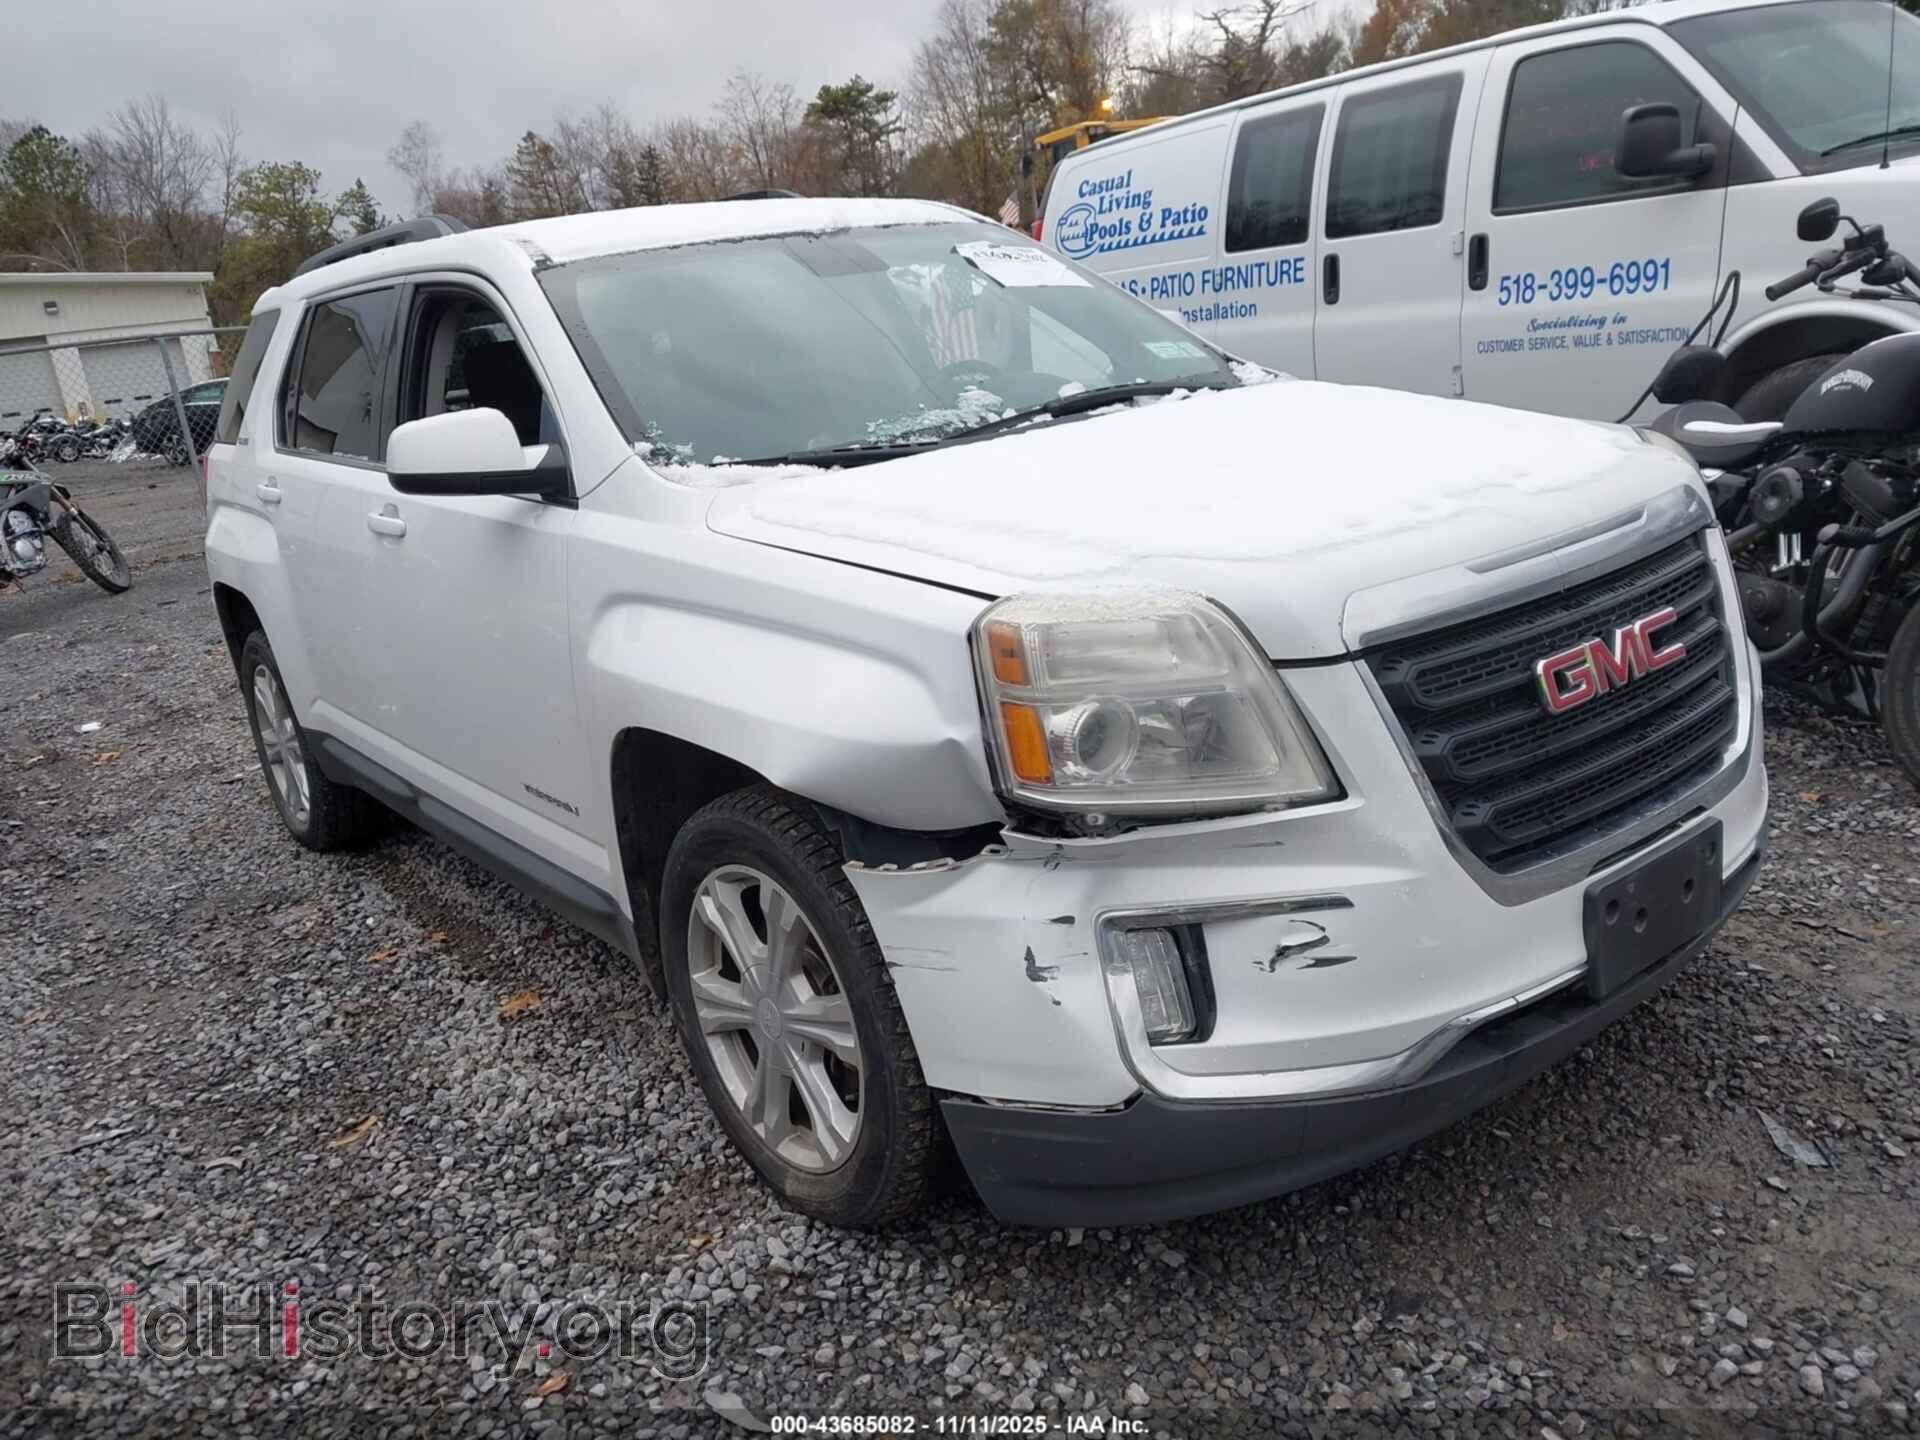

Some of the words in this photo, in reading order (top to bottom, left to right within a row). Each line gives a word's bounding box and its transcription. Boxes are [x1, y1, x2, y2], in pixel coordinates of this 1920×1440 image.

[1078, 169, 1133, 199] Casual
[1098, 189, 1153, 215] Living
[1087, 217, 1132, 243] Pools
[1138, 211, 1153, 233] &
[1160, 202, 1209, 229] Patio
[1150, 271, 1195, 301] PATIO
[1201, 256, 1306, 295] FURNITURE
[1498, 257, 1671, 306] 518-399-6991
[1526, 312, 1608, 333] Specializing
[1612, 311, 1628, 325] in
[1477, 338, 1525, 354] CUSTOMER
[1528, 334, 1570, 352] SERVICE,
[1572, 332, 1602, 348] VALUE
[1606, 331, 1613, 346] &
[1617, 327, 1691, 345] SATISFACTION
[1537, 606, 1687, 714] GMC
